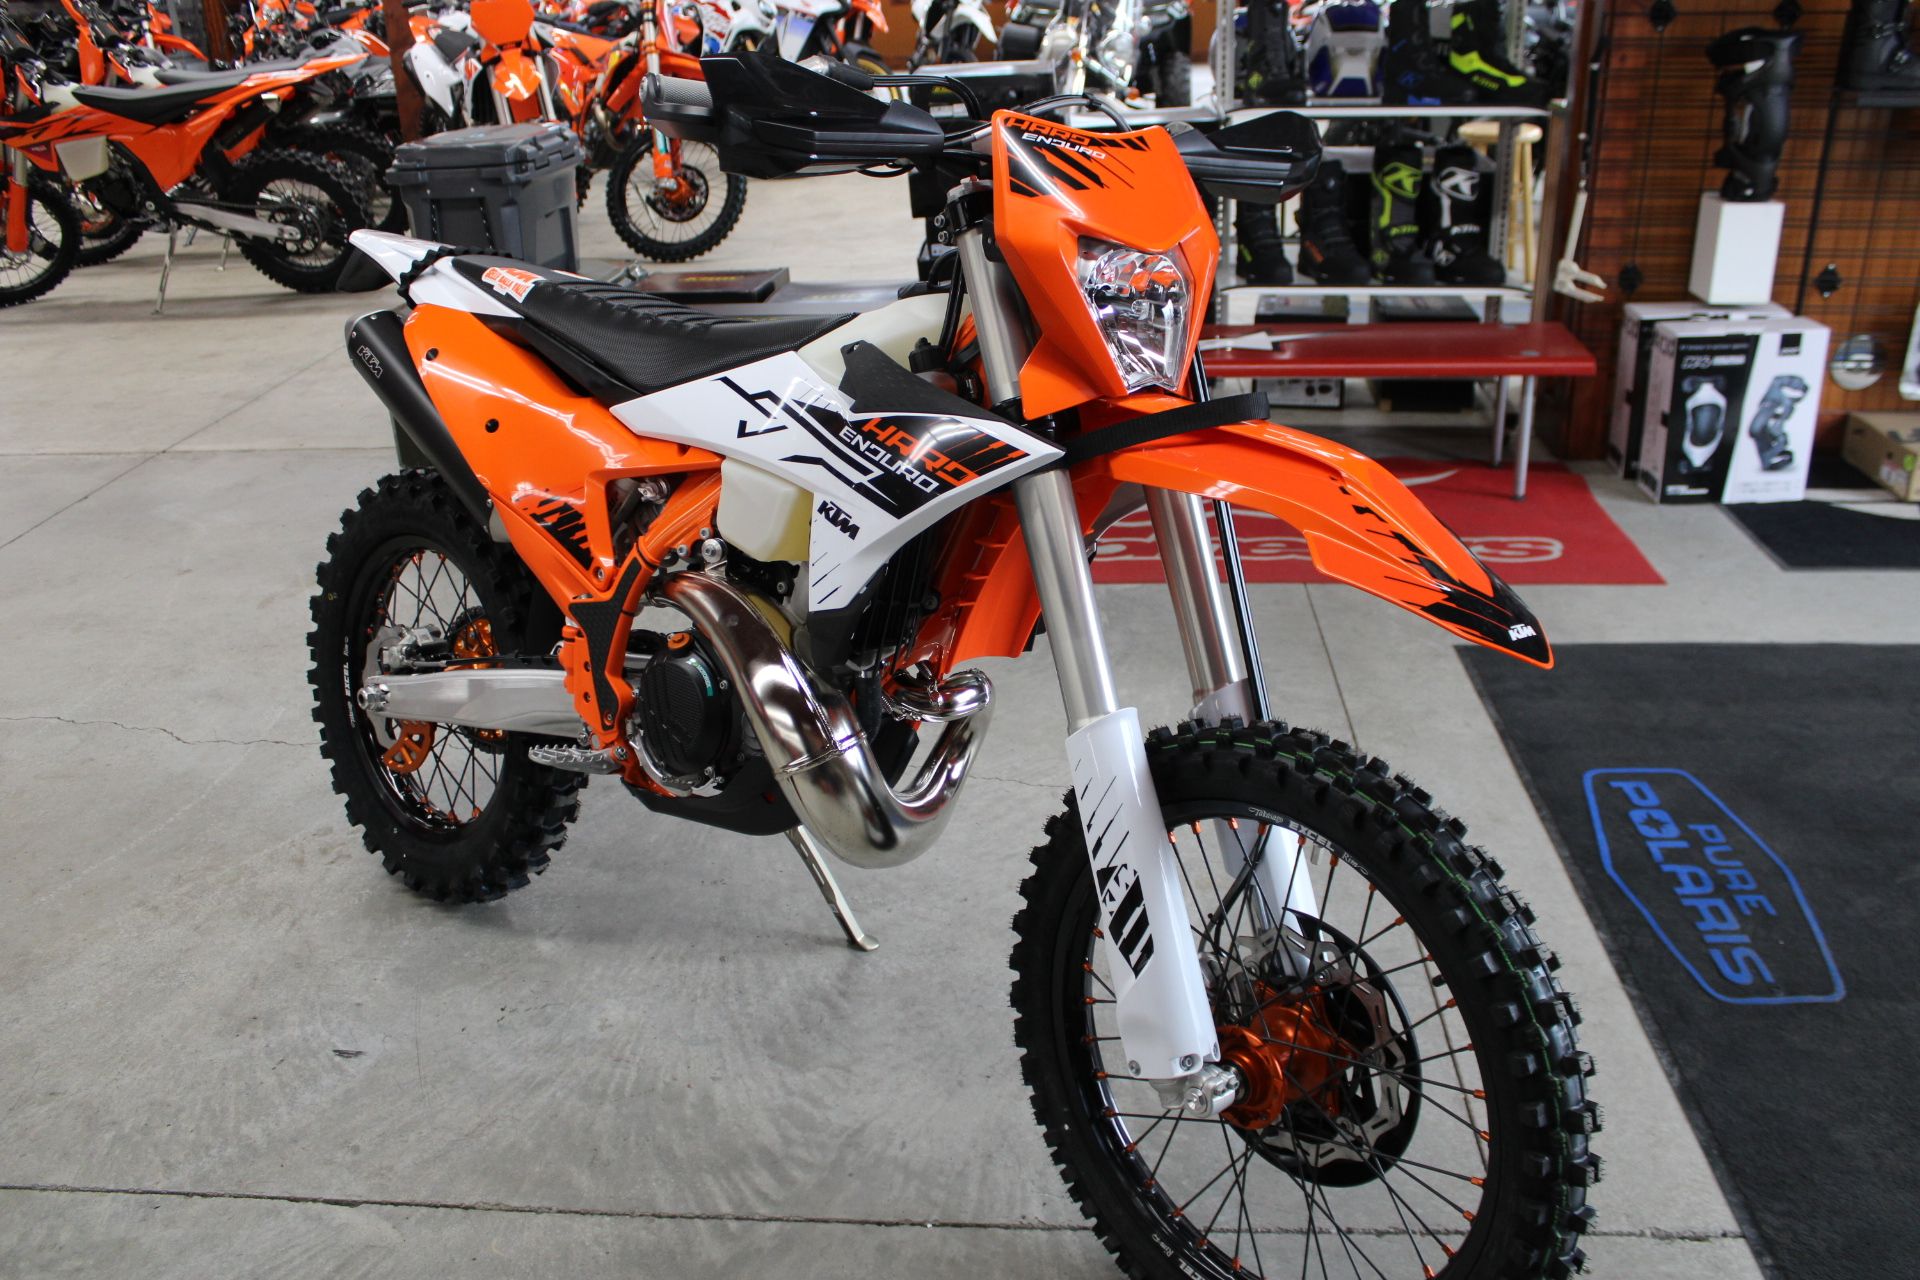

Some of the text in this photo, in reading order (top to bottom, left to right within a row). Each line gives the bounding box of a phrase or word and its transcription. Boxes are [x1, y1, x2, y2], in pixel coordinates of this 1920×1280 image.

[1006, 117, 1092, 146] HARD
[1021, 132, 1107, 160] ENDURO
[356, 345, 383, 378] KTM
[838, 425, 940, 494] ENDURO
[862, 417, 981, 488] HARD
[817, 500, 860, 540] KTM
[1508, 623, 1537, 641] KTM
[1288, 820, 1335, 852] EXCEL
[1608, 780, 1776, 986] POLARIS
[1687, 823, 1778, 917] PURE
